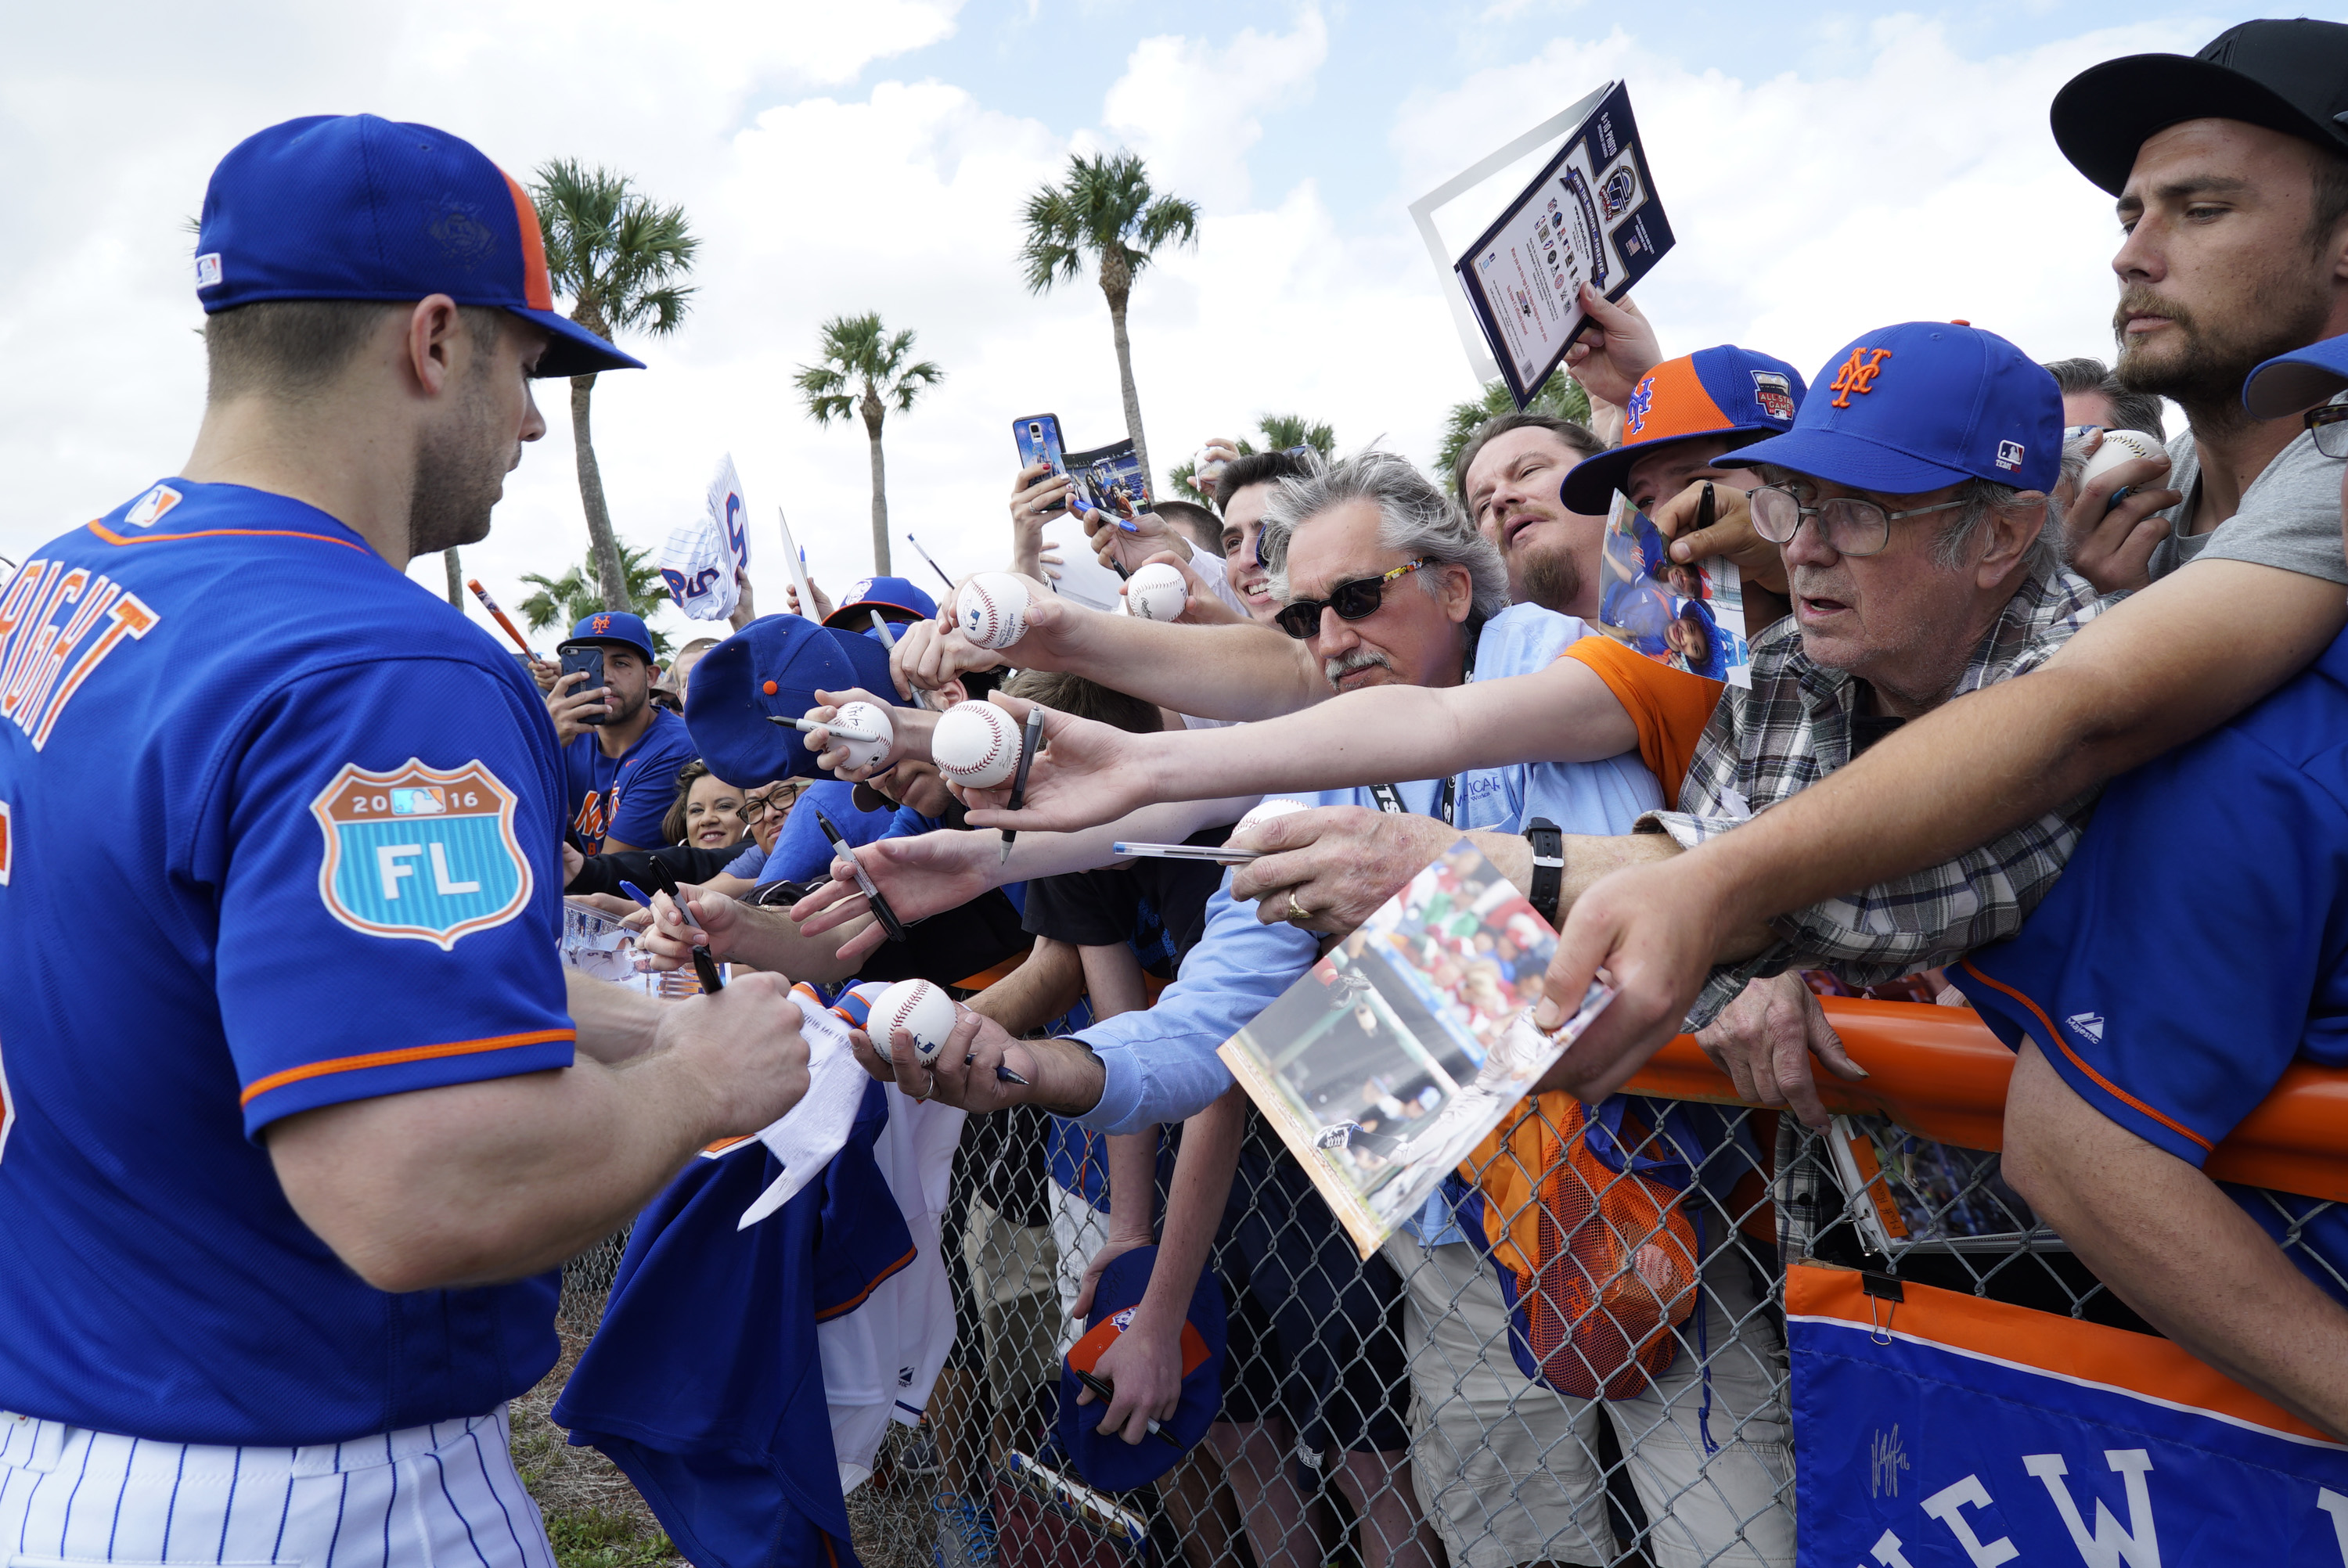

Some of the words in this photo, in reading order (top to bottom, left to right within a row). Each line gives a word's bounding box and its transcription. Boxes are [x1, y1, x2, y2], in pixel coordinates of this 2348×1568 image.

[1601, 112, 1611, 132] 8x10
[1605, 130, 1616, 155] PHOTO
[1573, 174, 1582, 190] OWN
[1830, 347, 1892, 408] NY
[1760, 393, 1777, 401] ALL
[1769, 401, 1791, 412] GAME
[0, 558, 161, 753] RIGHT
[352, 795, 387, 813] 20
[450, 792, 478, 808] 16
[1374, 784, 1401, 813] TS
[376, 842, 480, 900] FL
[2065, 1017, 2099, 1045] Majestic
